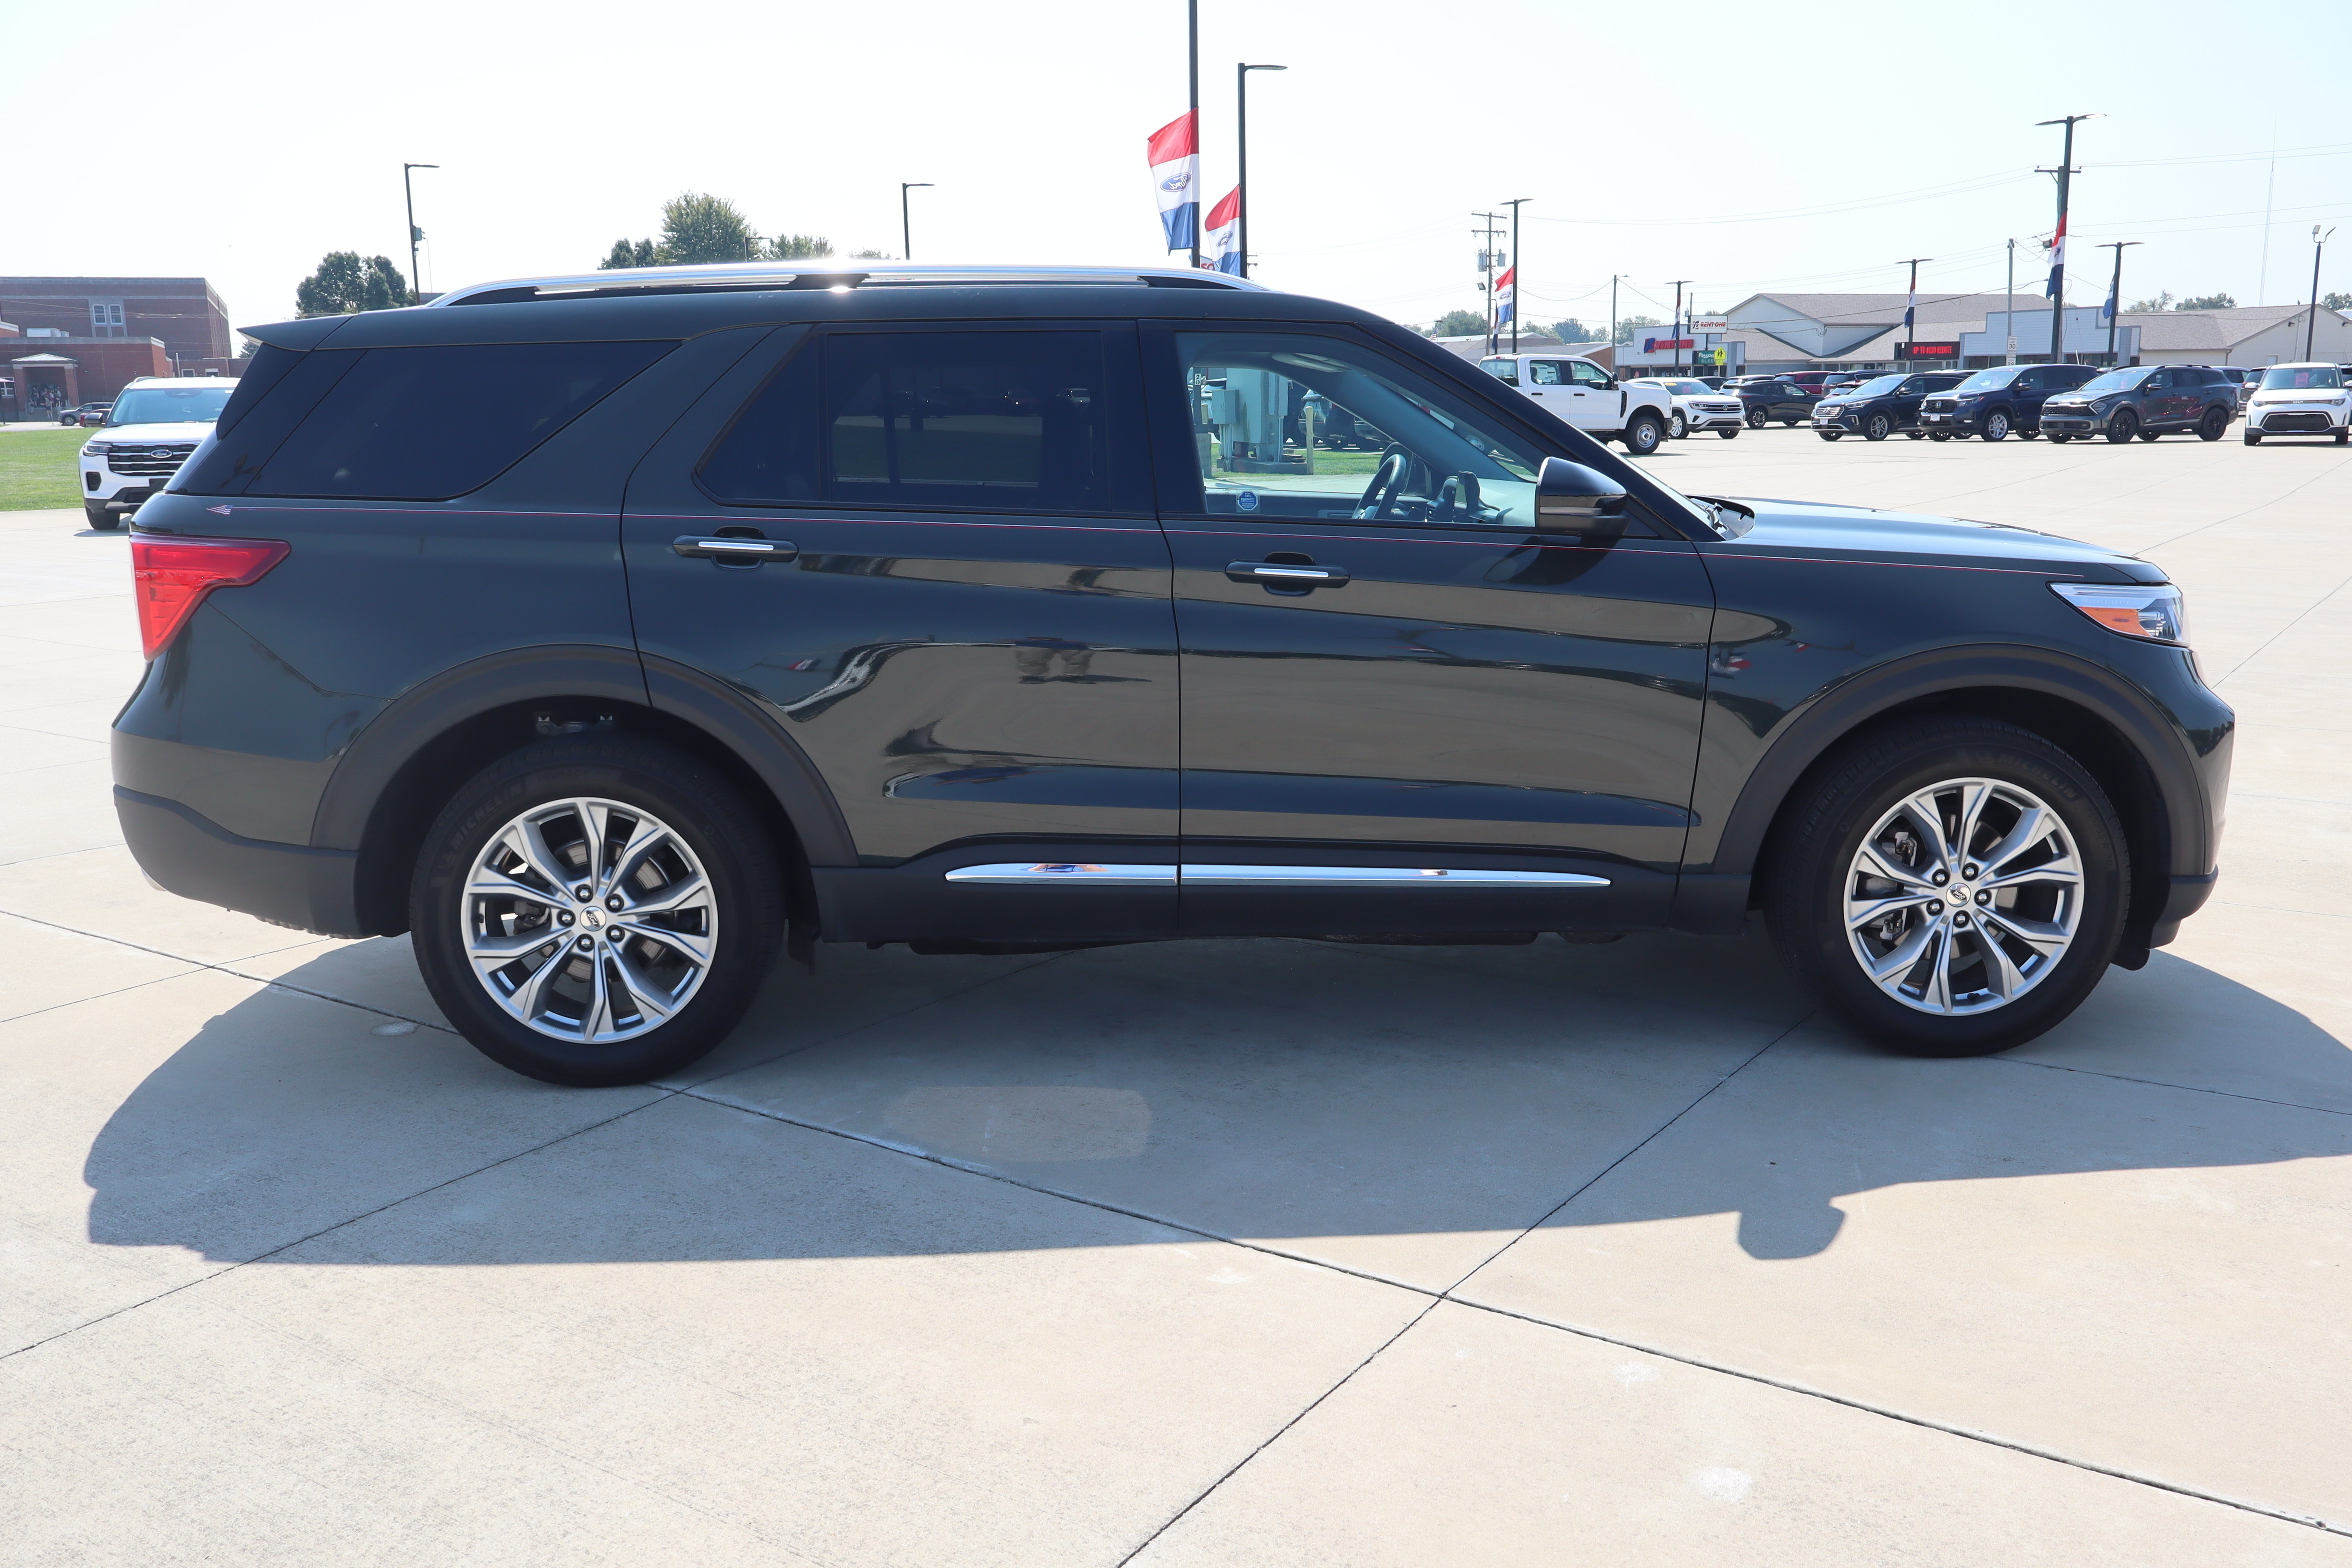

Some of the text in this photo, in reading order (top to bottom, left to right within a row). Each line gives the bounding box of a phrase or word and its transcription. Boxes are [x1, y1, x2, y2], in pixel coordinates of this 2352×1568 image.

[1998, 753, 2077, 798] MICHELIN
[450, 782, 522, 850] MICHELIN
[1953, 891, 1965, 900] Ford
[588, 913, 598, 924] Ford
